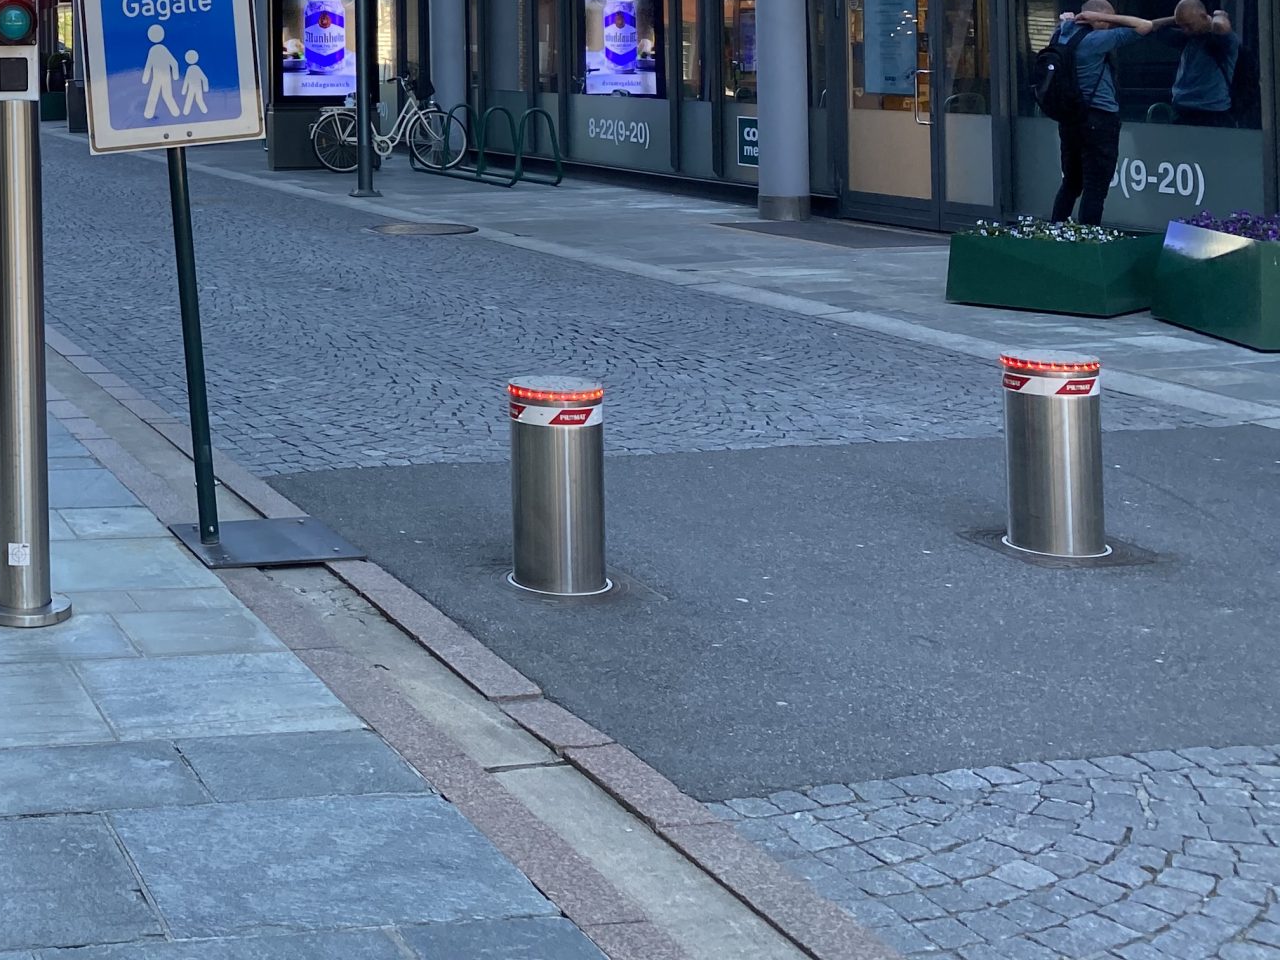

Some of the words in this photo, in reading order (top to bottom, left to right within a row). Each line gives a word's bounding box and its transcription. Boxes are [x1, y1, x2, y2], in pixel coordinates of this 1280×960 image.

[588, 117, 650, 150] 8-22(9-20)
[743, 127, 759, 141] co
[743, 146, 759, 157] me
